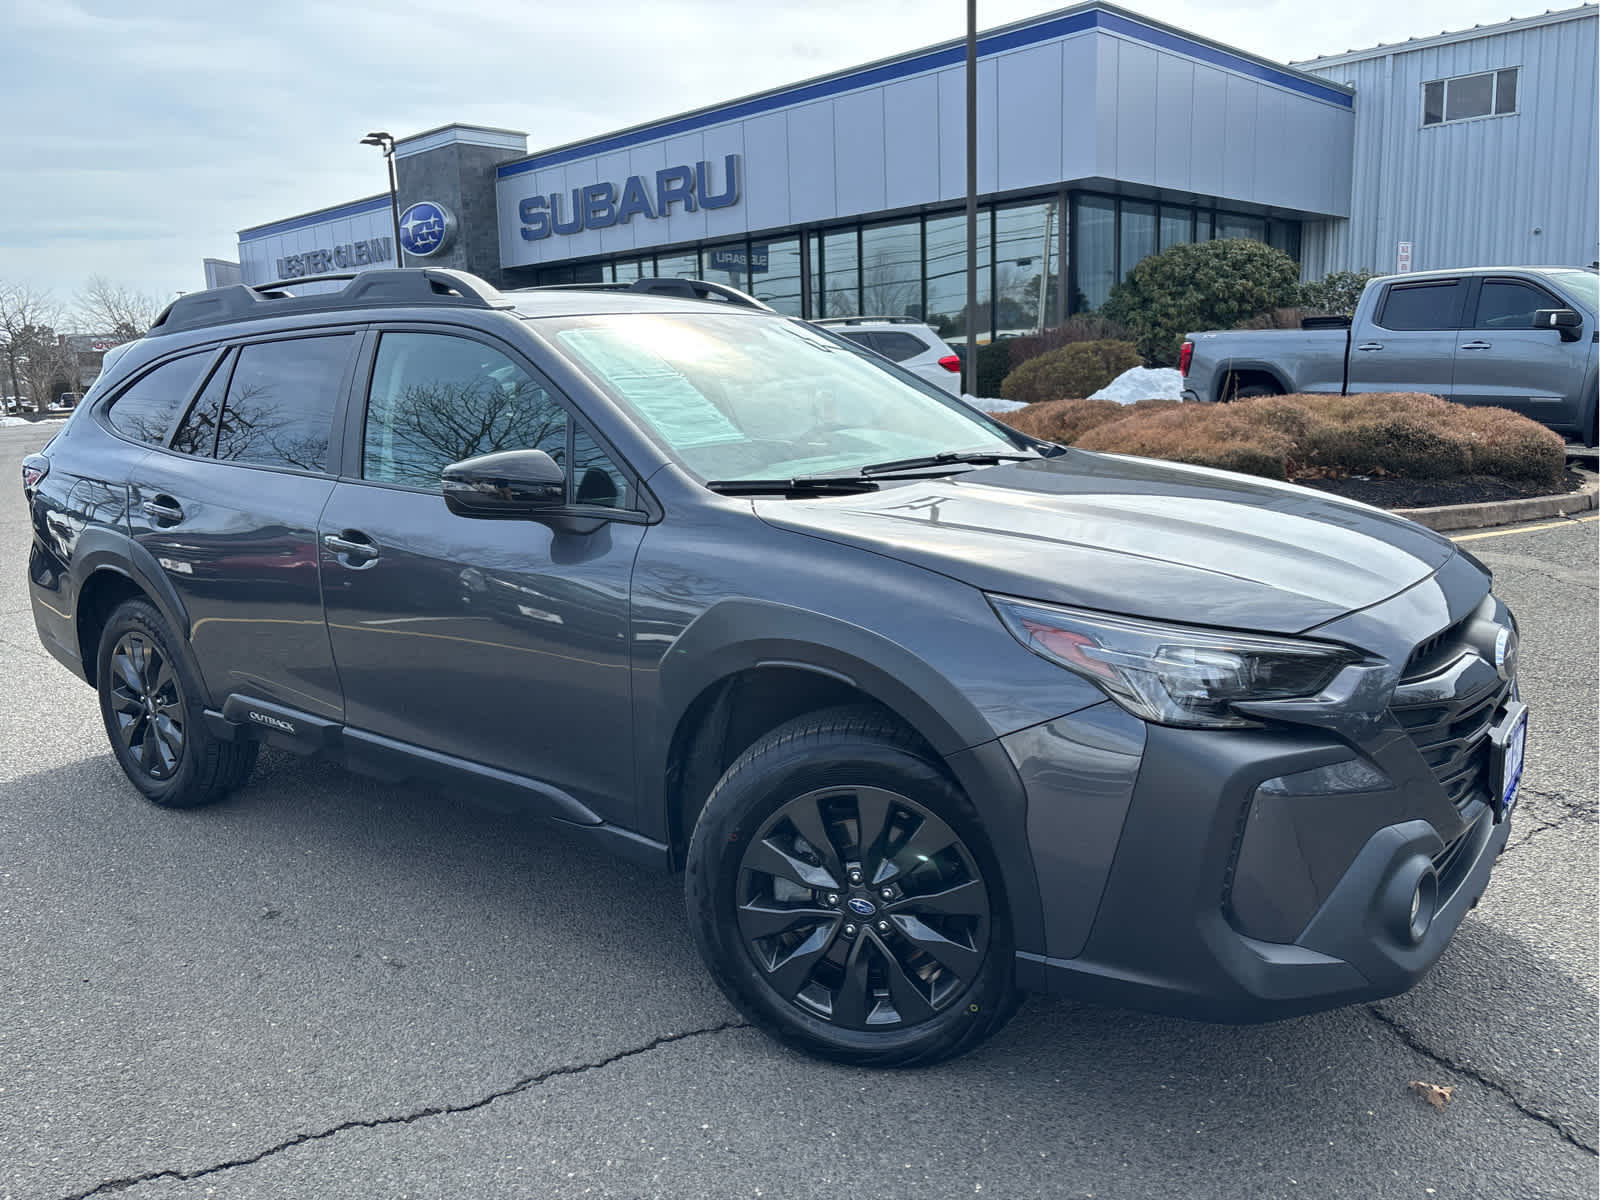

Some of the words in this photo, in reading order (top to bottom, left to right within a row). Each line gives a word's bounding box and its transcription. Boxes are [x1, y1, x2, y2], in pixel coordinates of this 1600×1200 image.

[519, 154, 738, 241] SUBARU
[277, 249, 332, 280] LESTER
[334, 237, 392, 269] GLENN
[249, 711, 295, 732] OUTBACK
